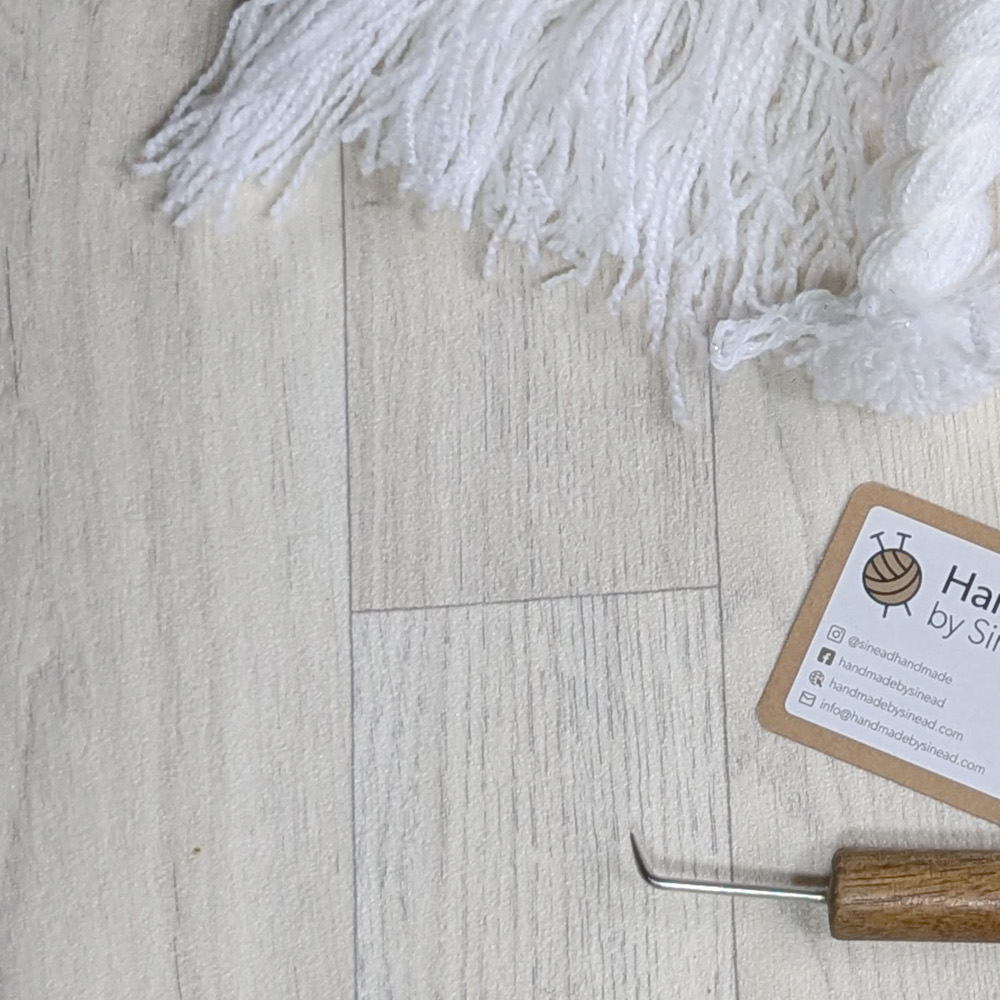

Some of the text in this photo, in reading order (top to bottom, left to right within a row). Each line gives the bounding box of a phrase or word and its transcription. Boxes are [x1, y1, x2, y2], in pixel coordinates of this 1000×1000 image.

[927, 601, 966, 639] by
[838, 657, 947, 709] handmadebysinead
[848, 636, 953, 685] @sineadhandmade
[828, 678, 964, 742] handmadebysinead.com
[819, 699, 986, 775] info@handmadebysinead.com
